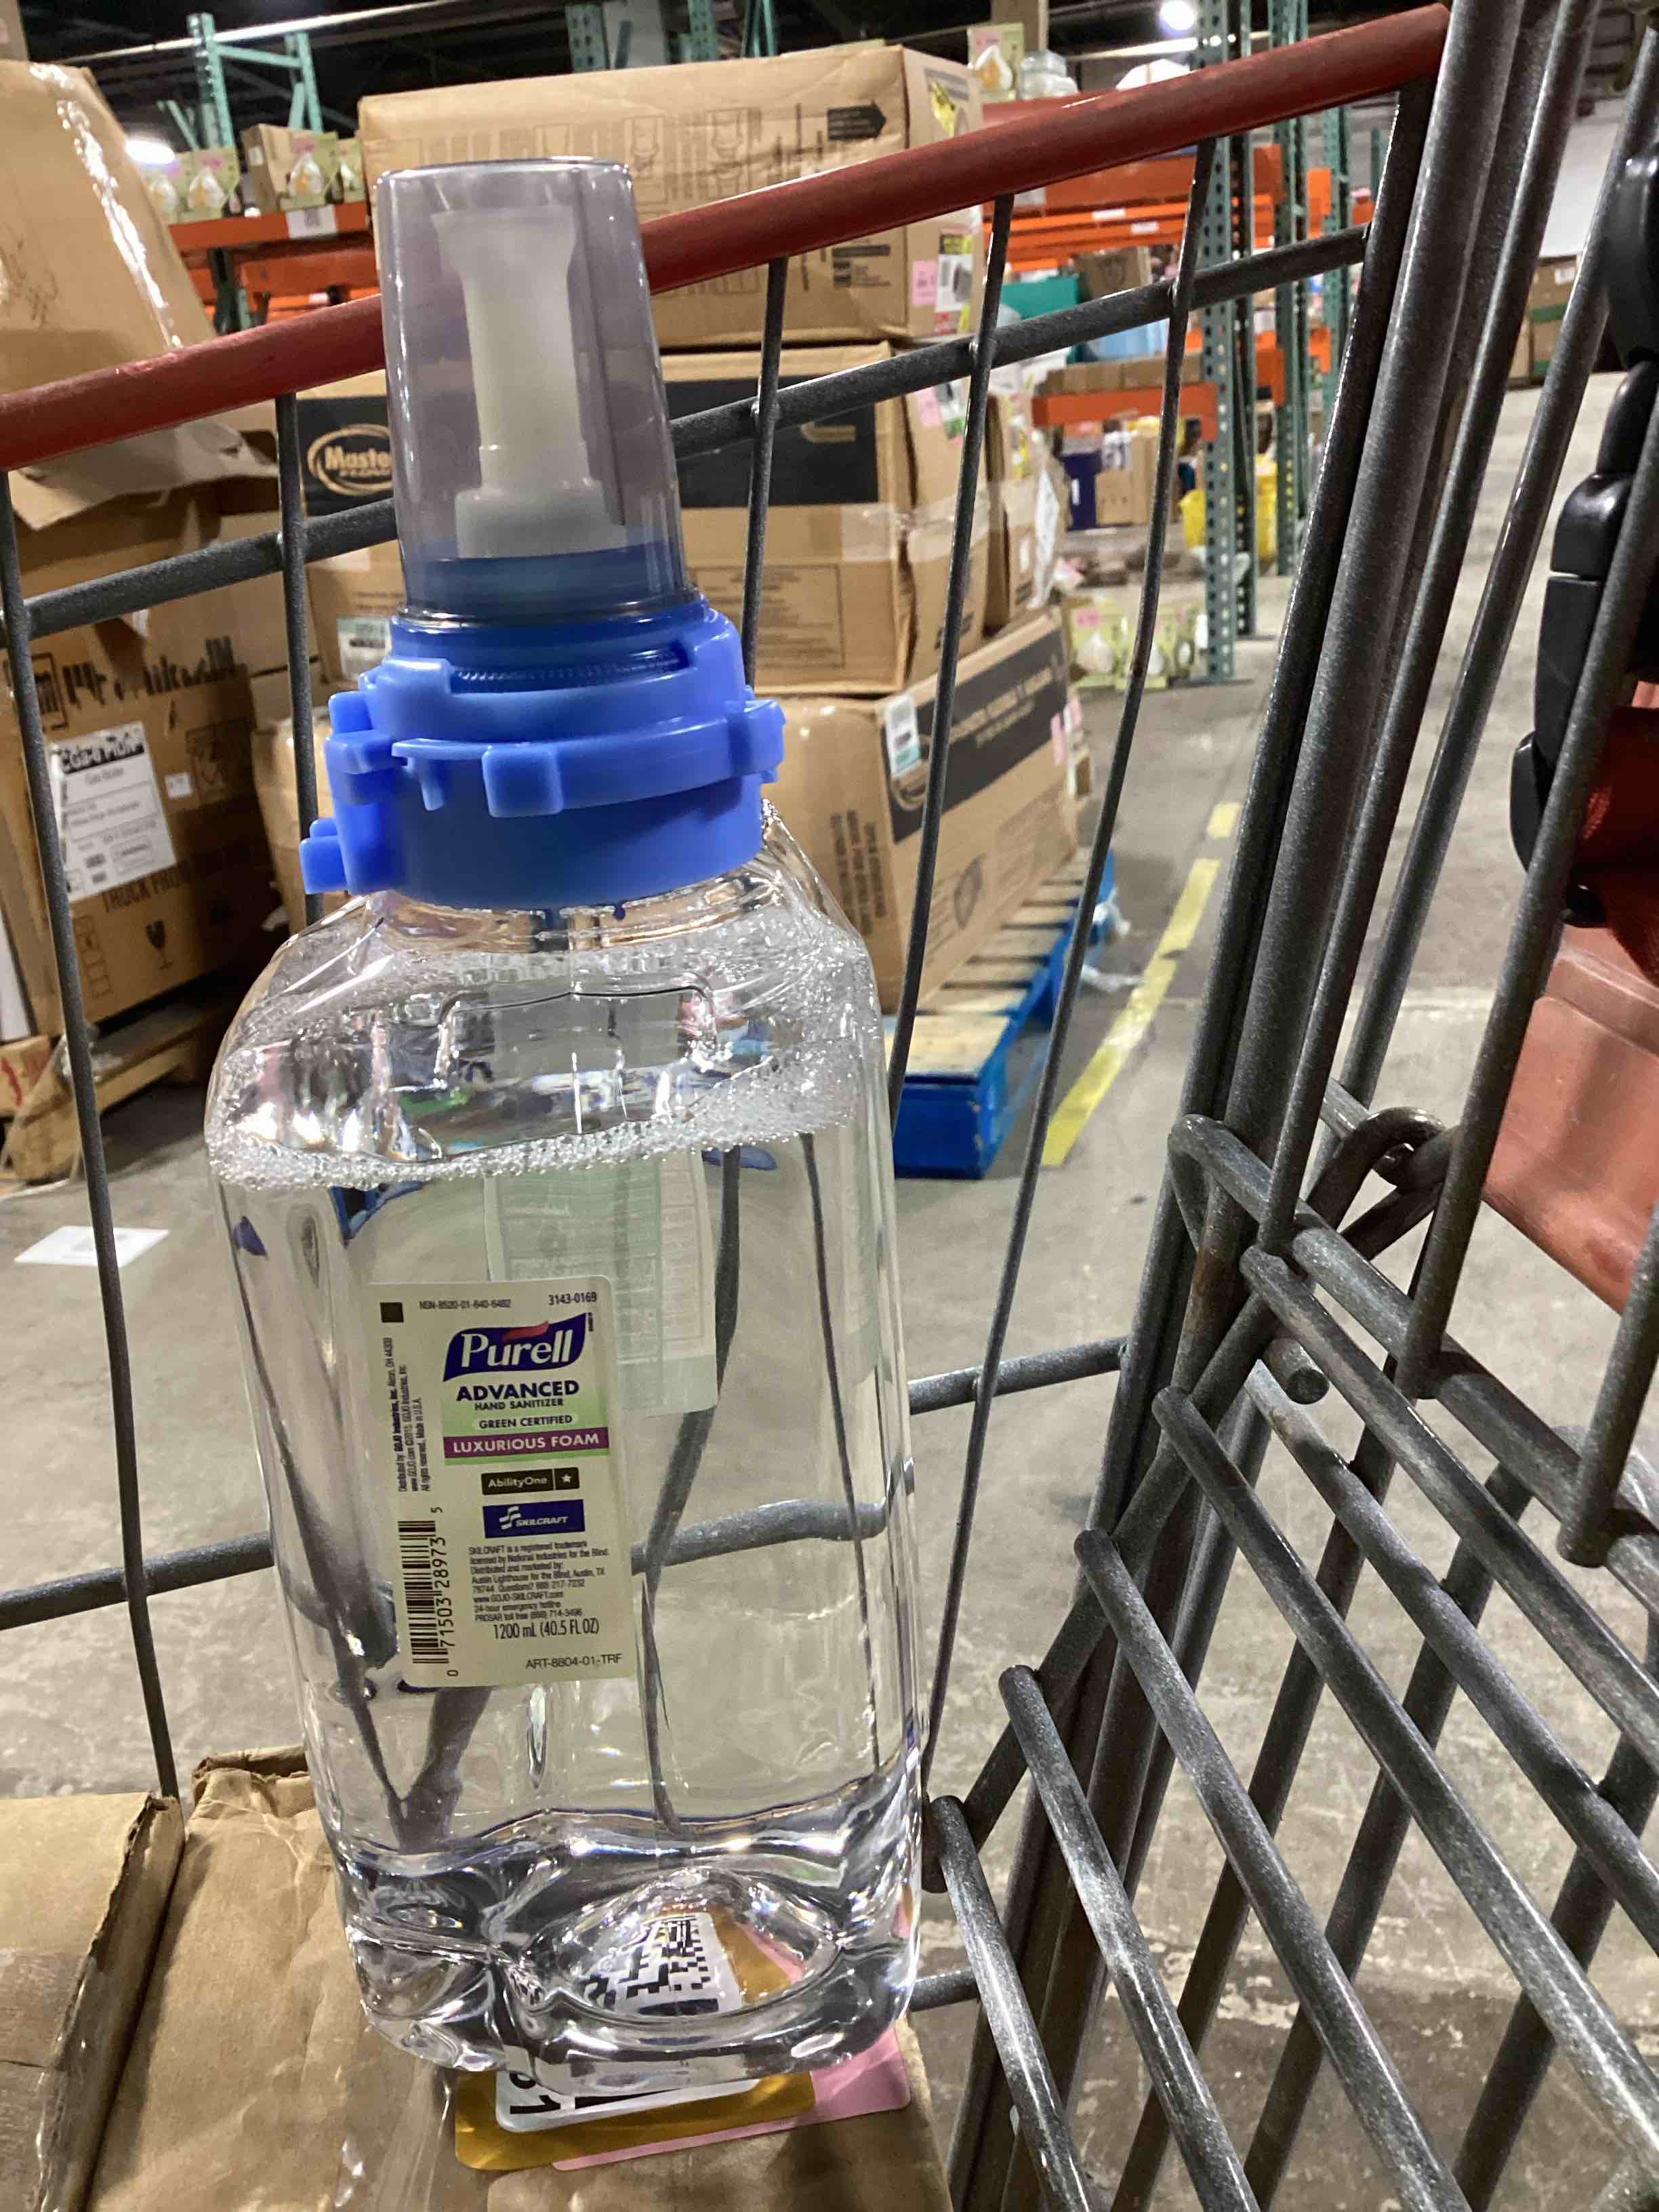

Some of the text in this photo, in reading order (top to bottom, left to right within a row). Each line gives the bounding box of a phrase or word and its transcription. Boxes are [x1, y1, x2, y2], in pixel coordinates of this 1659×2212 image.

[548, 1292, 597, 1305] 3143-0169
[461, 1329, 573, 1368] Purell
[456, 1380, 579, 1401] ADVANCED
[474, 1398, 564, 1411] HAND SANITIZER
[415, 1423, 425, 1438] Made
[479, 1415, 572, 1429] GREEN CERTIFIED
[453, 1433, 599, 1453] LUXURIOUS FOAM
[488, 1477, 548, 1488] AbilityOne
[516, 1515, 568, 1527] SKILCRAFT
[430, 1536, 450, 1589] 28973
[436, 1597, 455, 1647] 71503
[493, 1617, 599, 1639] 1200 mL (40.5 FL OZ)
